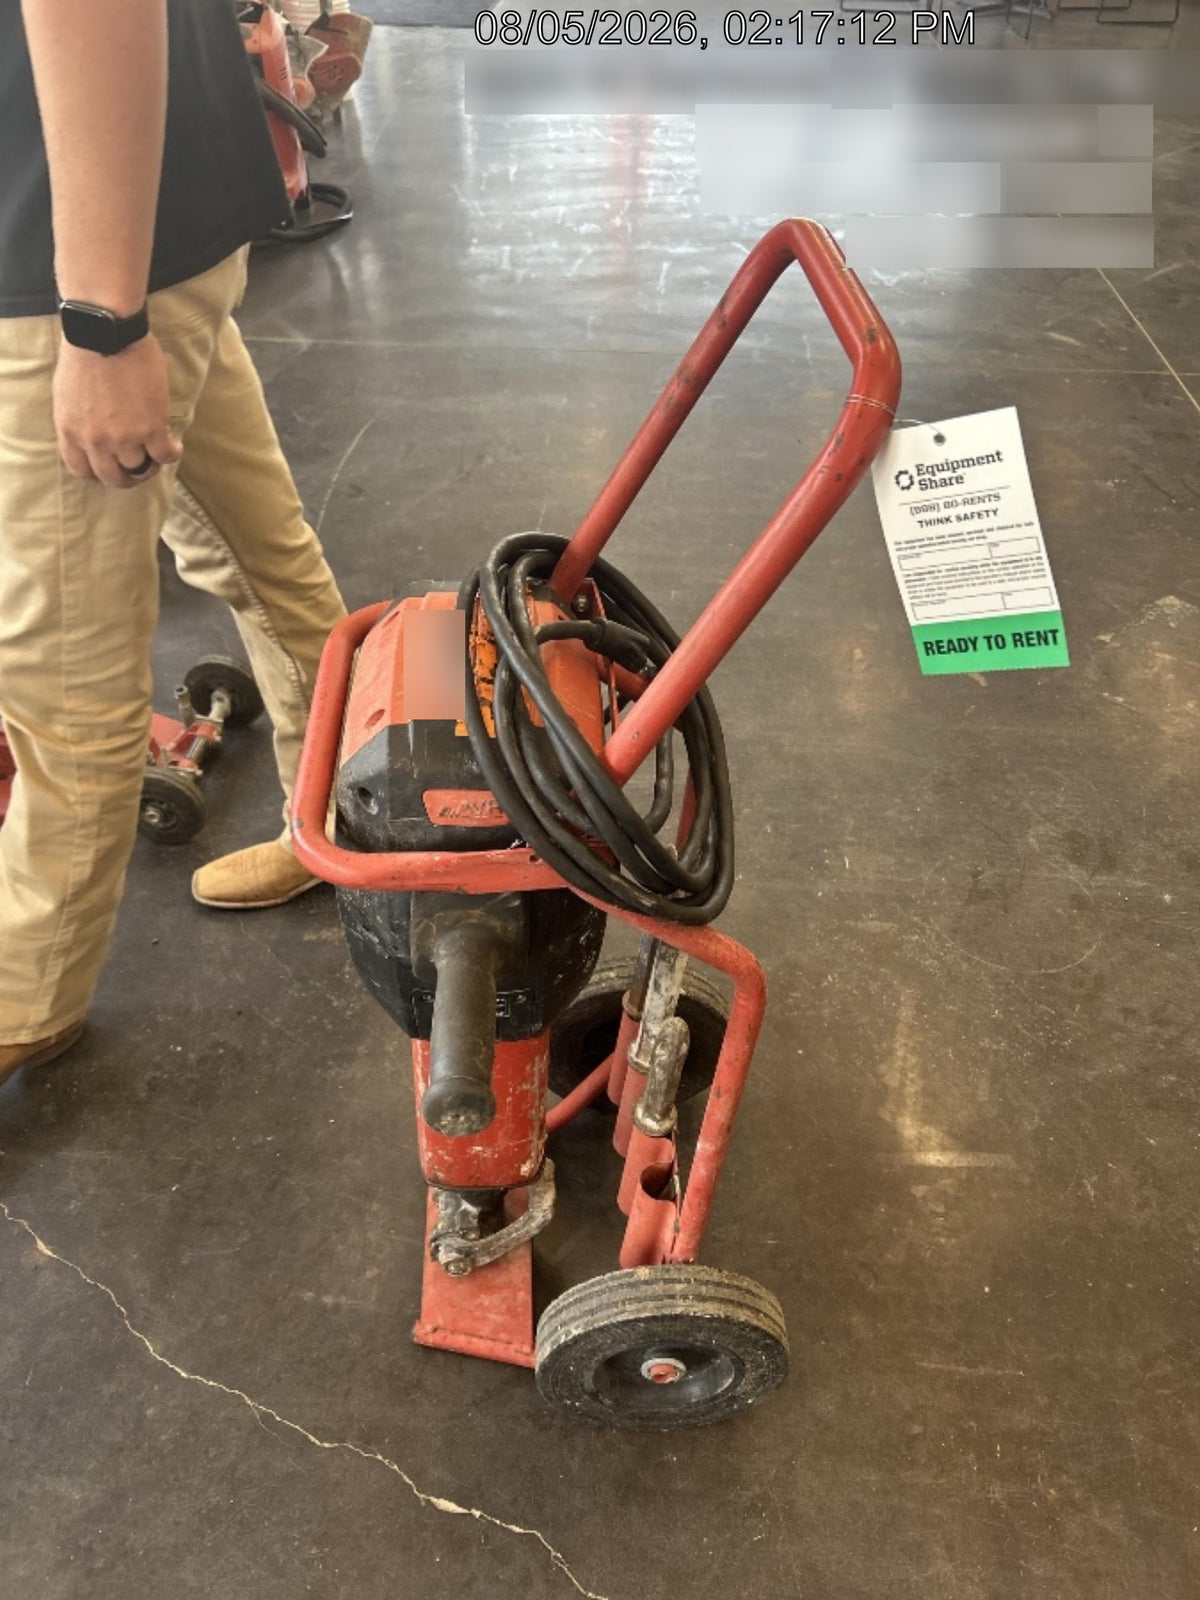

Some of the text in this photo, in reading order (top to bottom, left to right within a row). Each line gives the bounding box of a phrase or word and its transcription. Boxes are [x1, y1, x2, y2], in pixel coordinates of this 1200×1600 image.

[915, 450, 1004, 477] Equipment
[918, 473, 965, 491] Share
[917, 508, 999, 529] THINK SAFETY
[923, 629, 1059, 656] READY TO RENT
